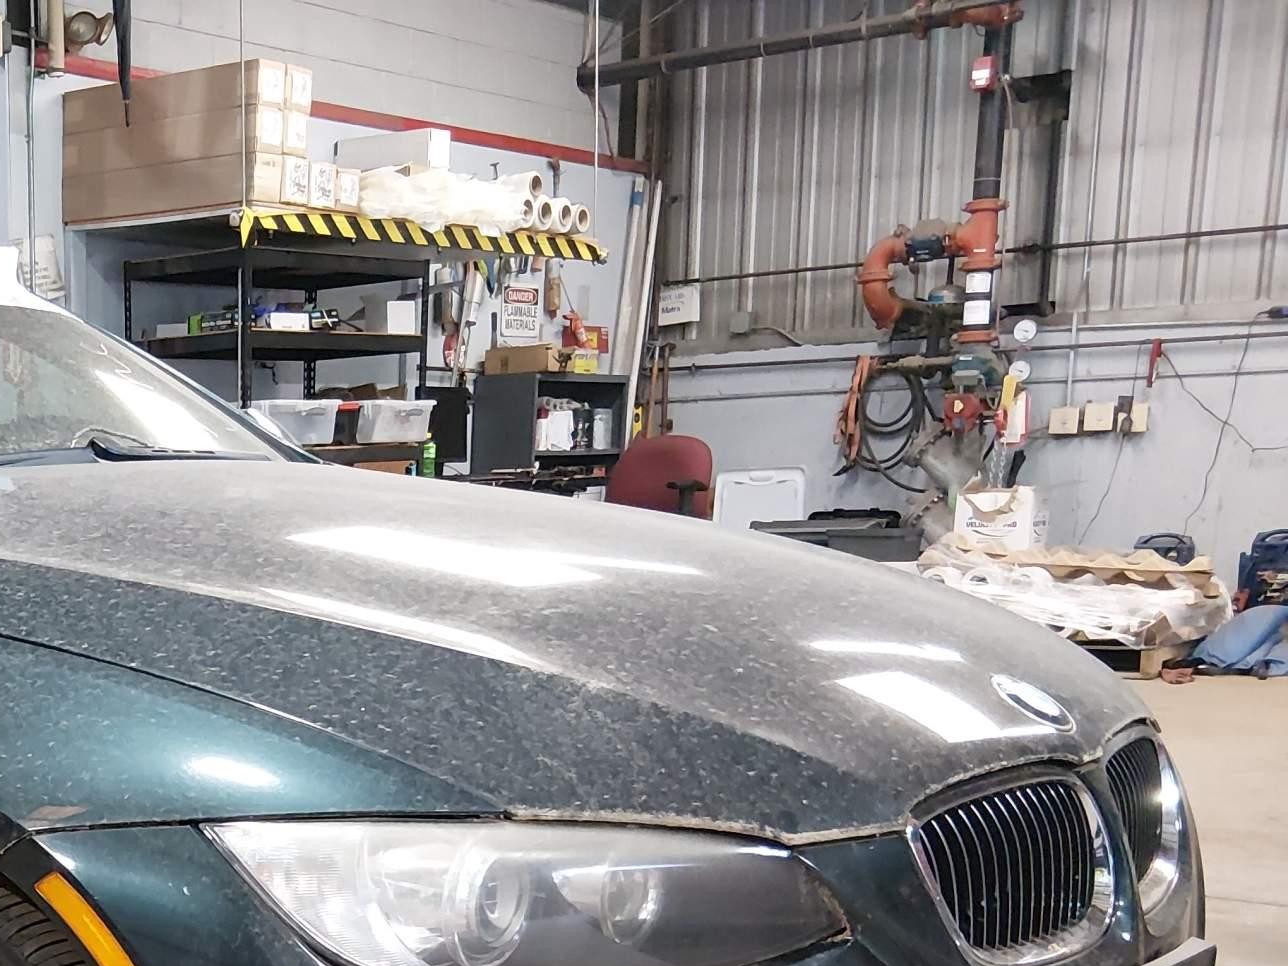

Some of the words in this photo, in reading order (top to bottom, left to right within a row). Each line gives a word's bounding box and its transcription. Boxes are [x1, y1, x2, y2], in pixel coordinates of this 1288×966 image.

[508, 290, 534, 302] DANGER
[503, 304, 538, 319] FLAMMABLE
[504, 318, 536, 332] MATERIALS
